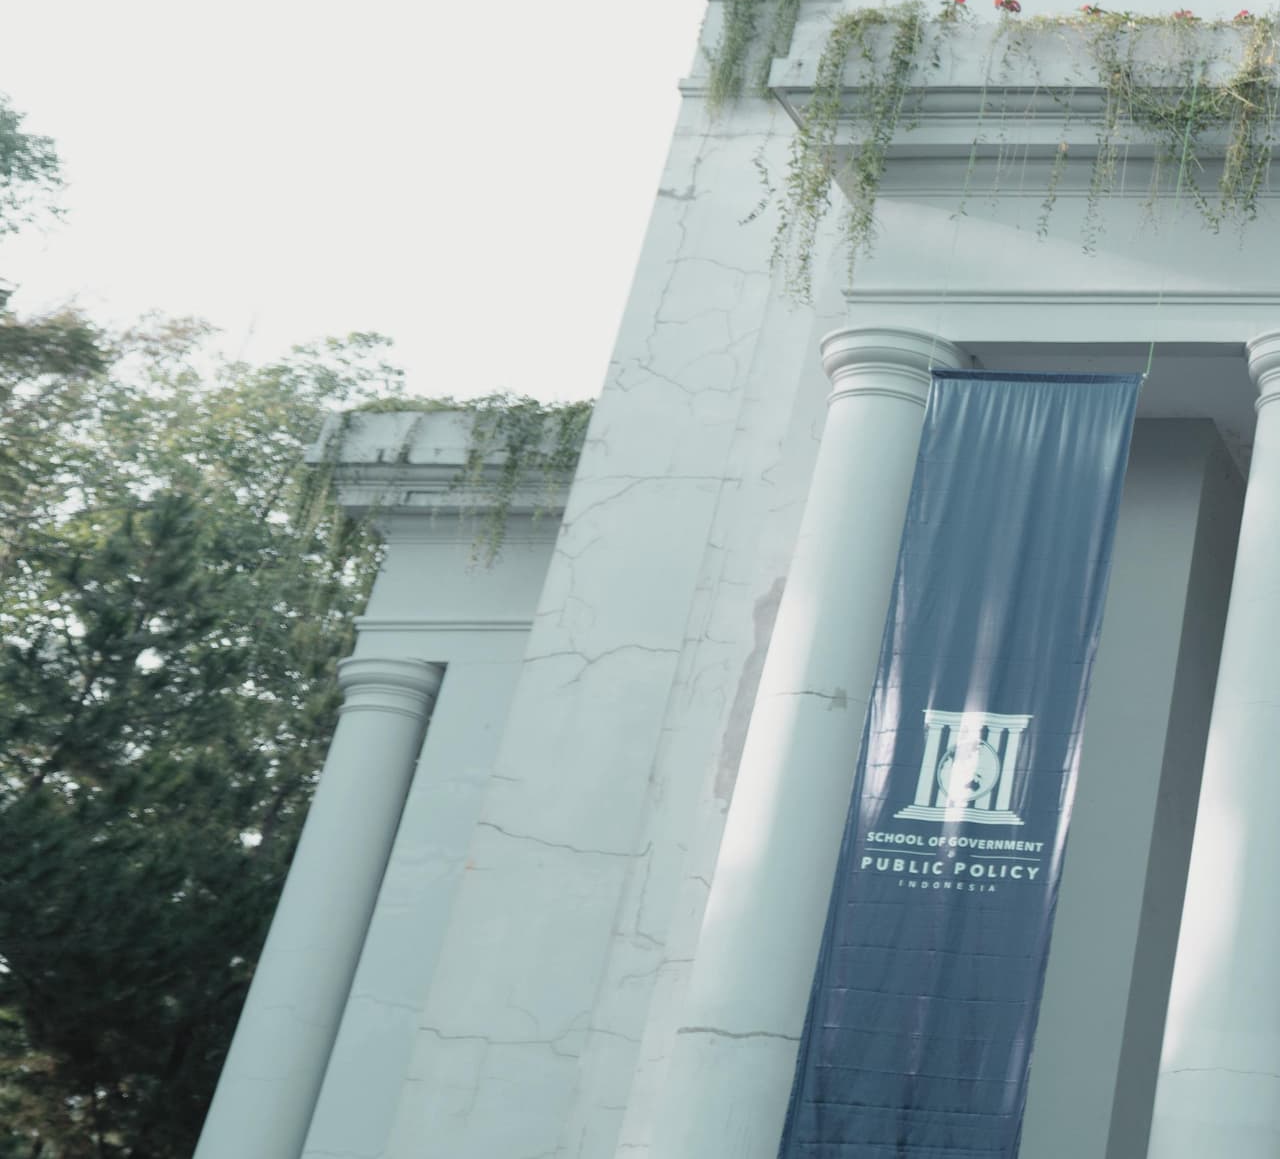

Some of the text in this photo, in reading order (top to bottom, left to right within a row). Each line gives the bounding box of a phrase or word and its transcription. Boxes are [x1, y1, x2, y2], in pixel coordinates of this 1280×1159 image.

[866, 831, 1044, 852] SCHOOL OF GOVERNMENT
[861, 856, 1040, 880] PUBLIC POLICY
[899, 879, 996, 892] INDONESIA
